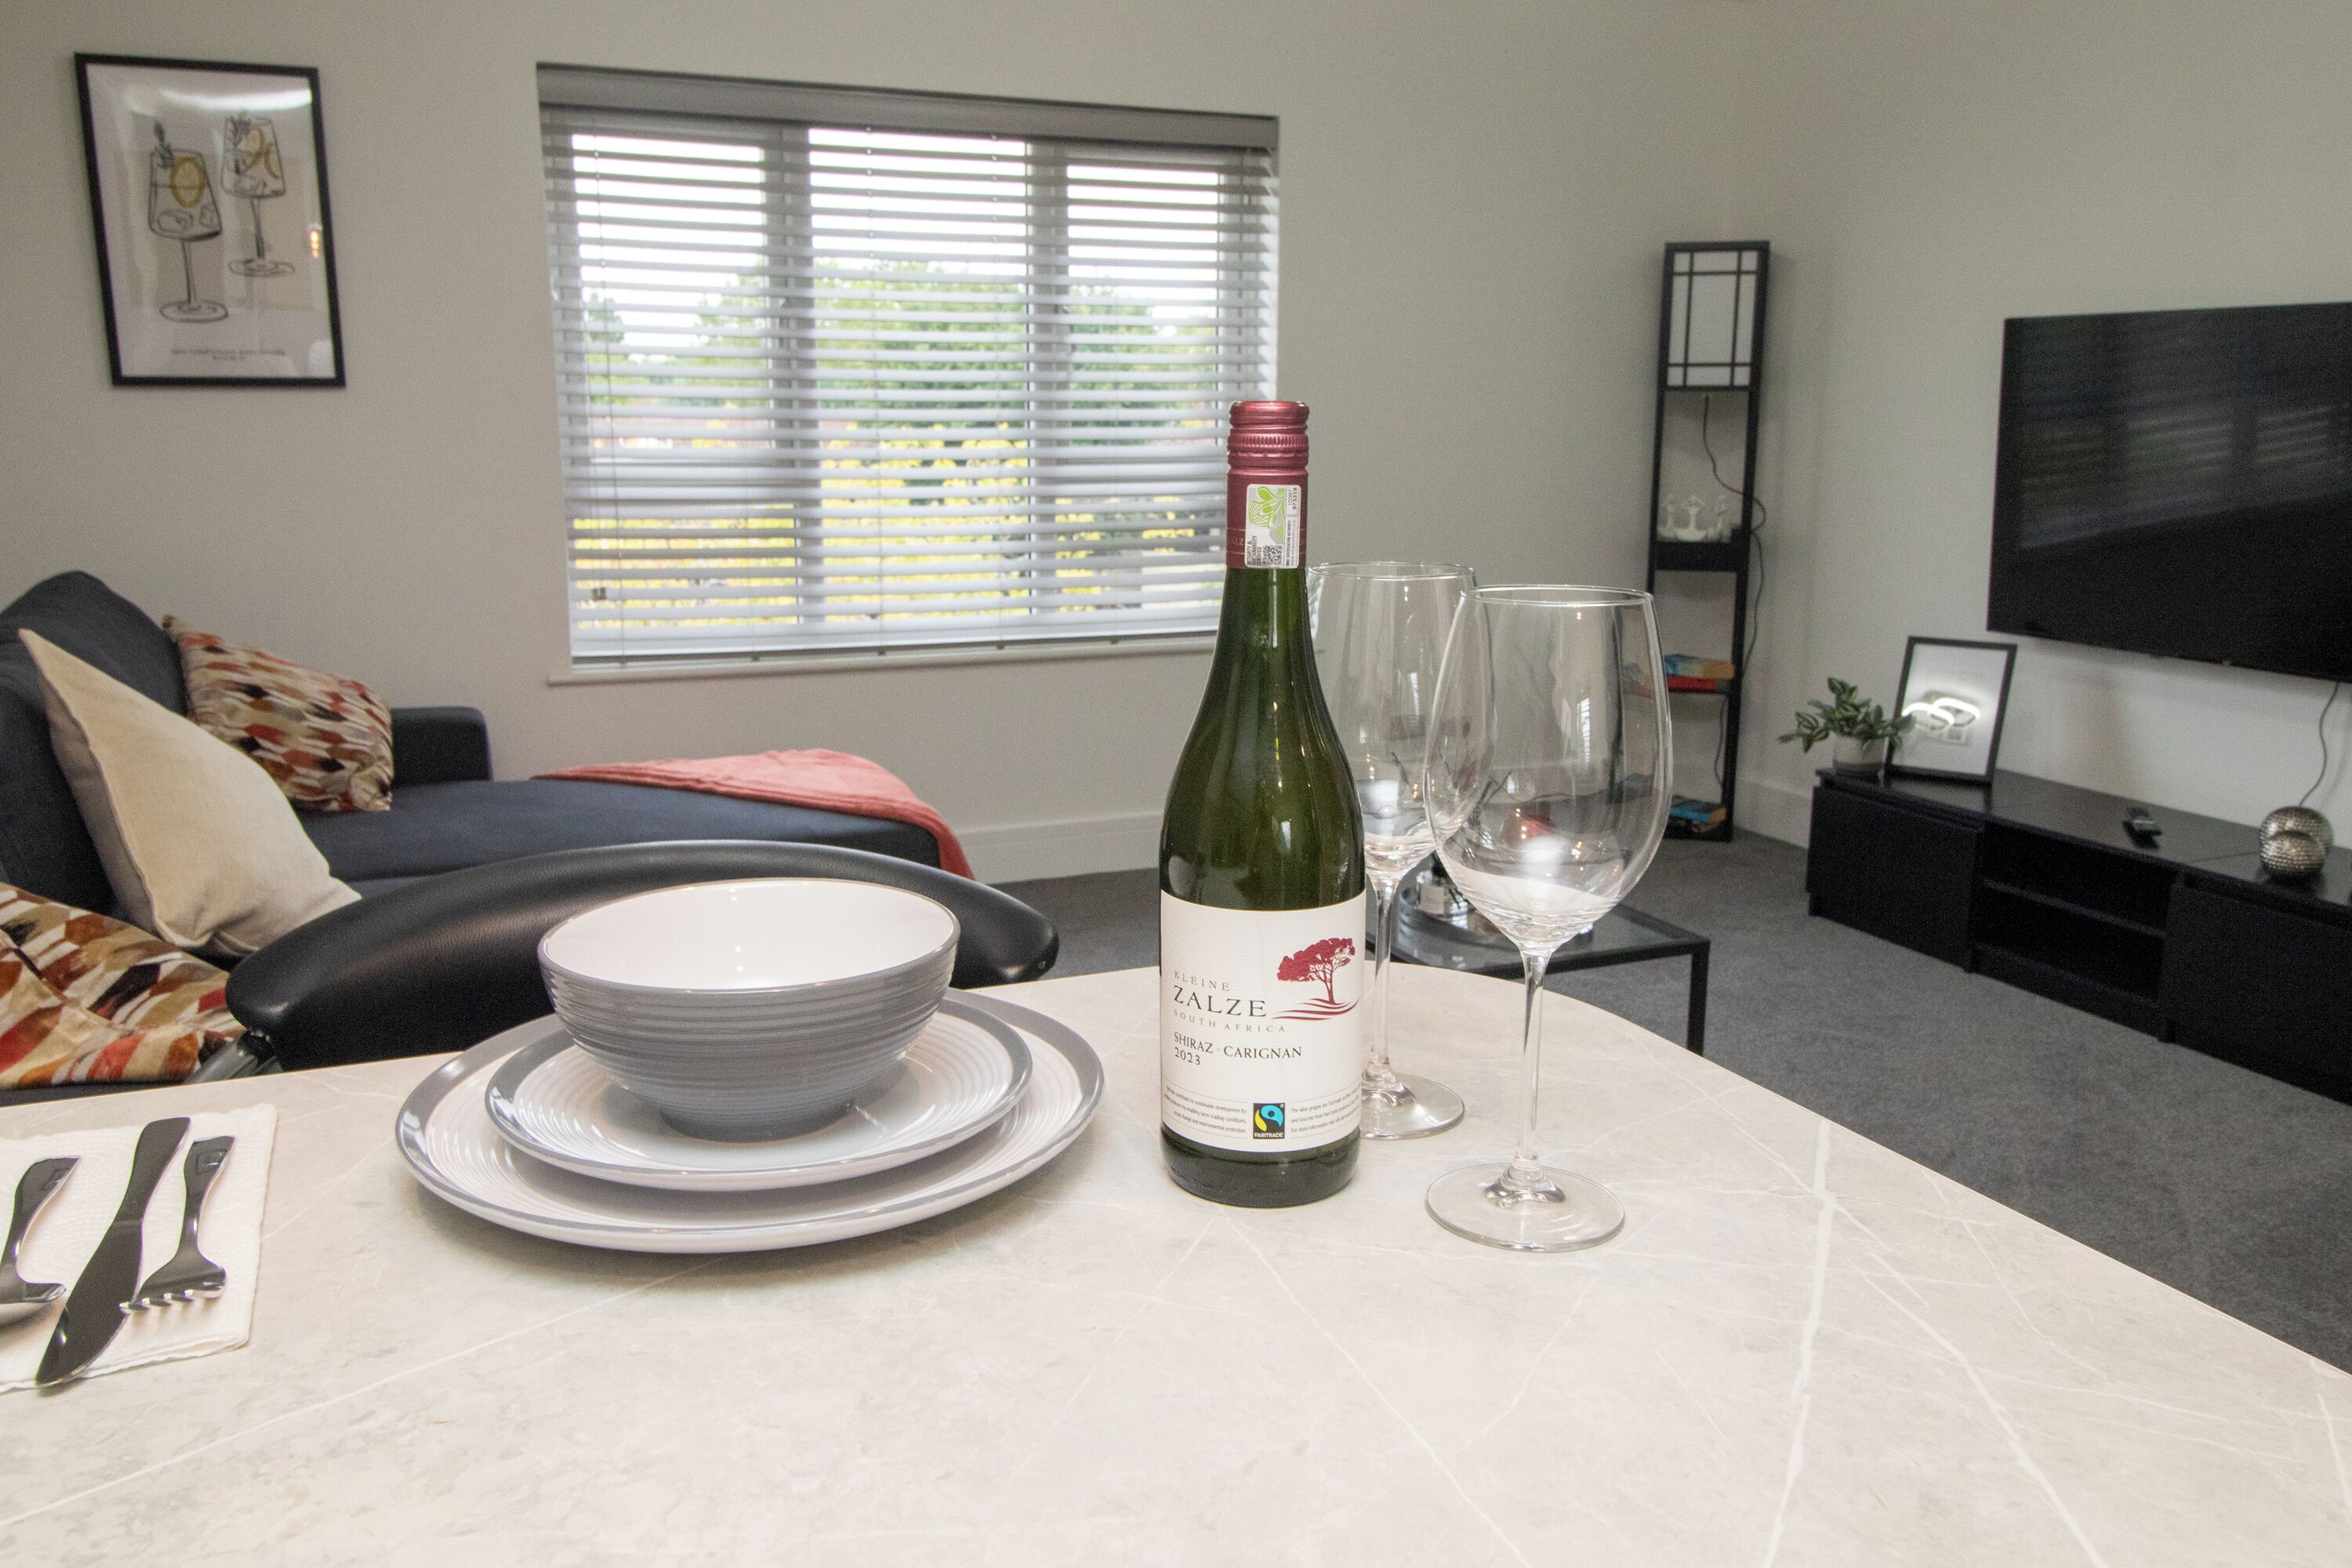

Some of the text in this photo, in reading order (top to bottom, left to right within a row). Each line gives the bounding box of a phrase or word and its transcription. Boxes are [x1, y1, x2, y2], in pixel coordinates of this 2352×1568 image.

[1174, 970, 1230, 992] KLEINE
[1174, 985, 1267, 1017] ZALZE
[1174, 1010, 1285, 1033] SOUTH AFRICA
[1174, 1031, 1214, 1054] SHIRAZ
[1223, 1046, 1302, 1059] CARIGNAN
[1174, 1047, 1200, 1065] 2023
[1210, 1113, 1225, 1123] trading
[1214, 1104, 1240, 1113] development
